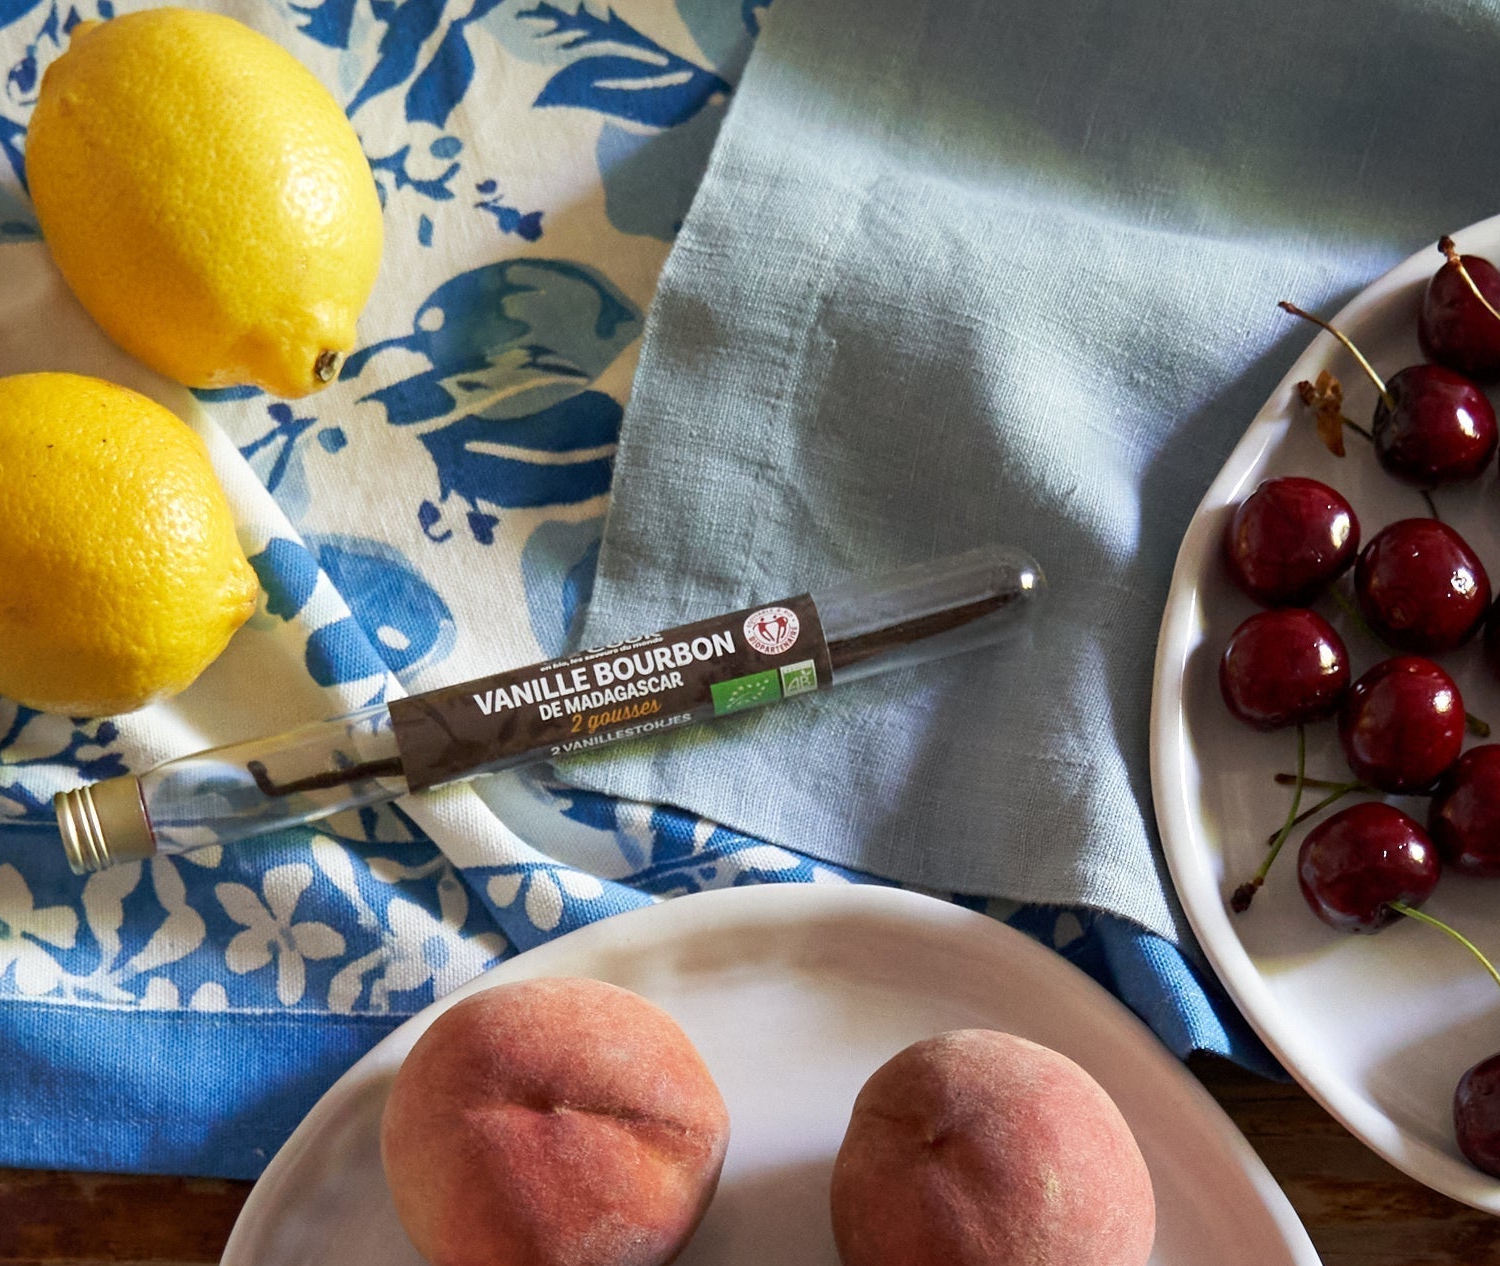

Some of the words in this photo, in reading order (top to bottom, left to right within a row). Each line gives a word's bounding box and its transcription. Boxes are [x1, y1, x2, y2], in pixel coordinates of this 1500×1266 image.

[620, 643, 632, 652] du
[632, 636, 664, 649] monde
[748, 626, 798, 654] BIOPARTENAIRE
[474, 664, 591, 717] VANILLE
[593, 630, 736, 687] BOURBON
[538, 701, 564, 721] DE
[564, 671, 685, 715] MADAGASCAR
[570, 713, 584, 733] 2
[587, 699, 661, 734] gousses
[550, 746, 561, 756] 2
